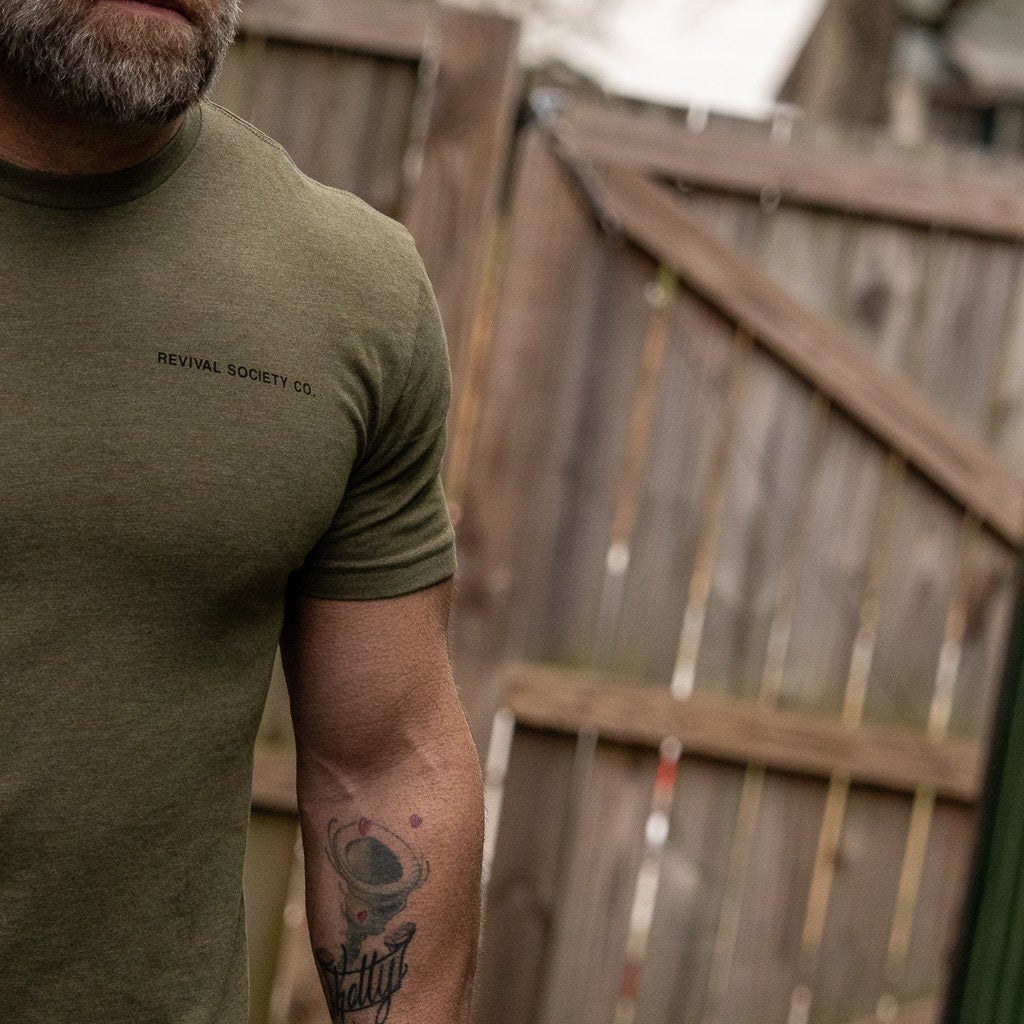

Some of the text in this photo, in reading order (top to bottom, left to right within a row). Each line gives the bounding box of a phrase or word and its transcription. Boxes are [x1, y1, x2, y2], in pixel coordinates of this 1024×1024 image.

[157, 352, 316, 397] REVIVAL SOCIETY CO.
